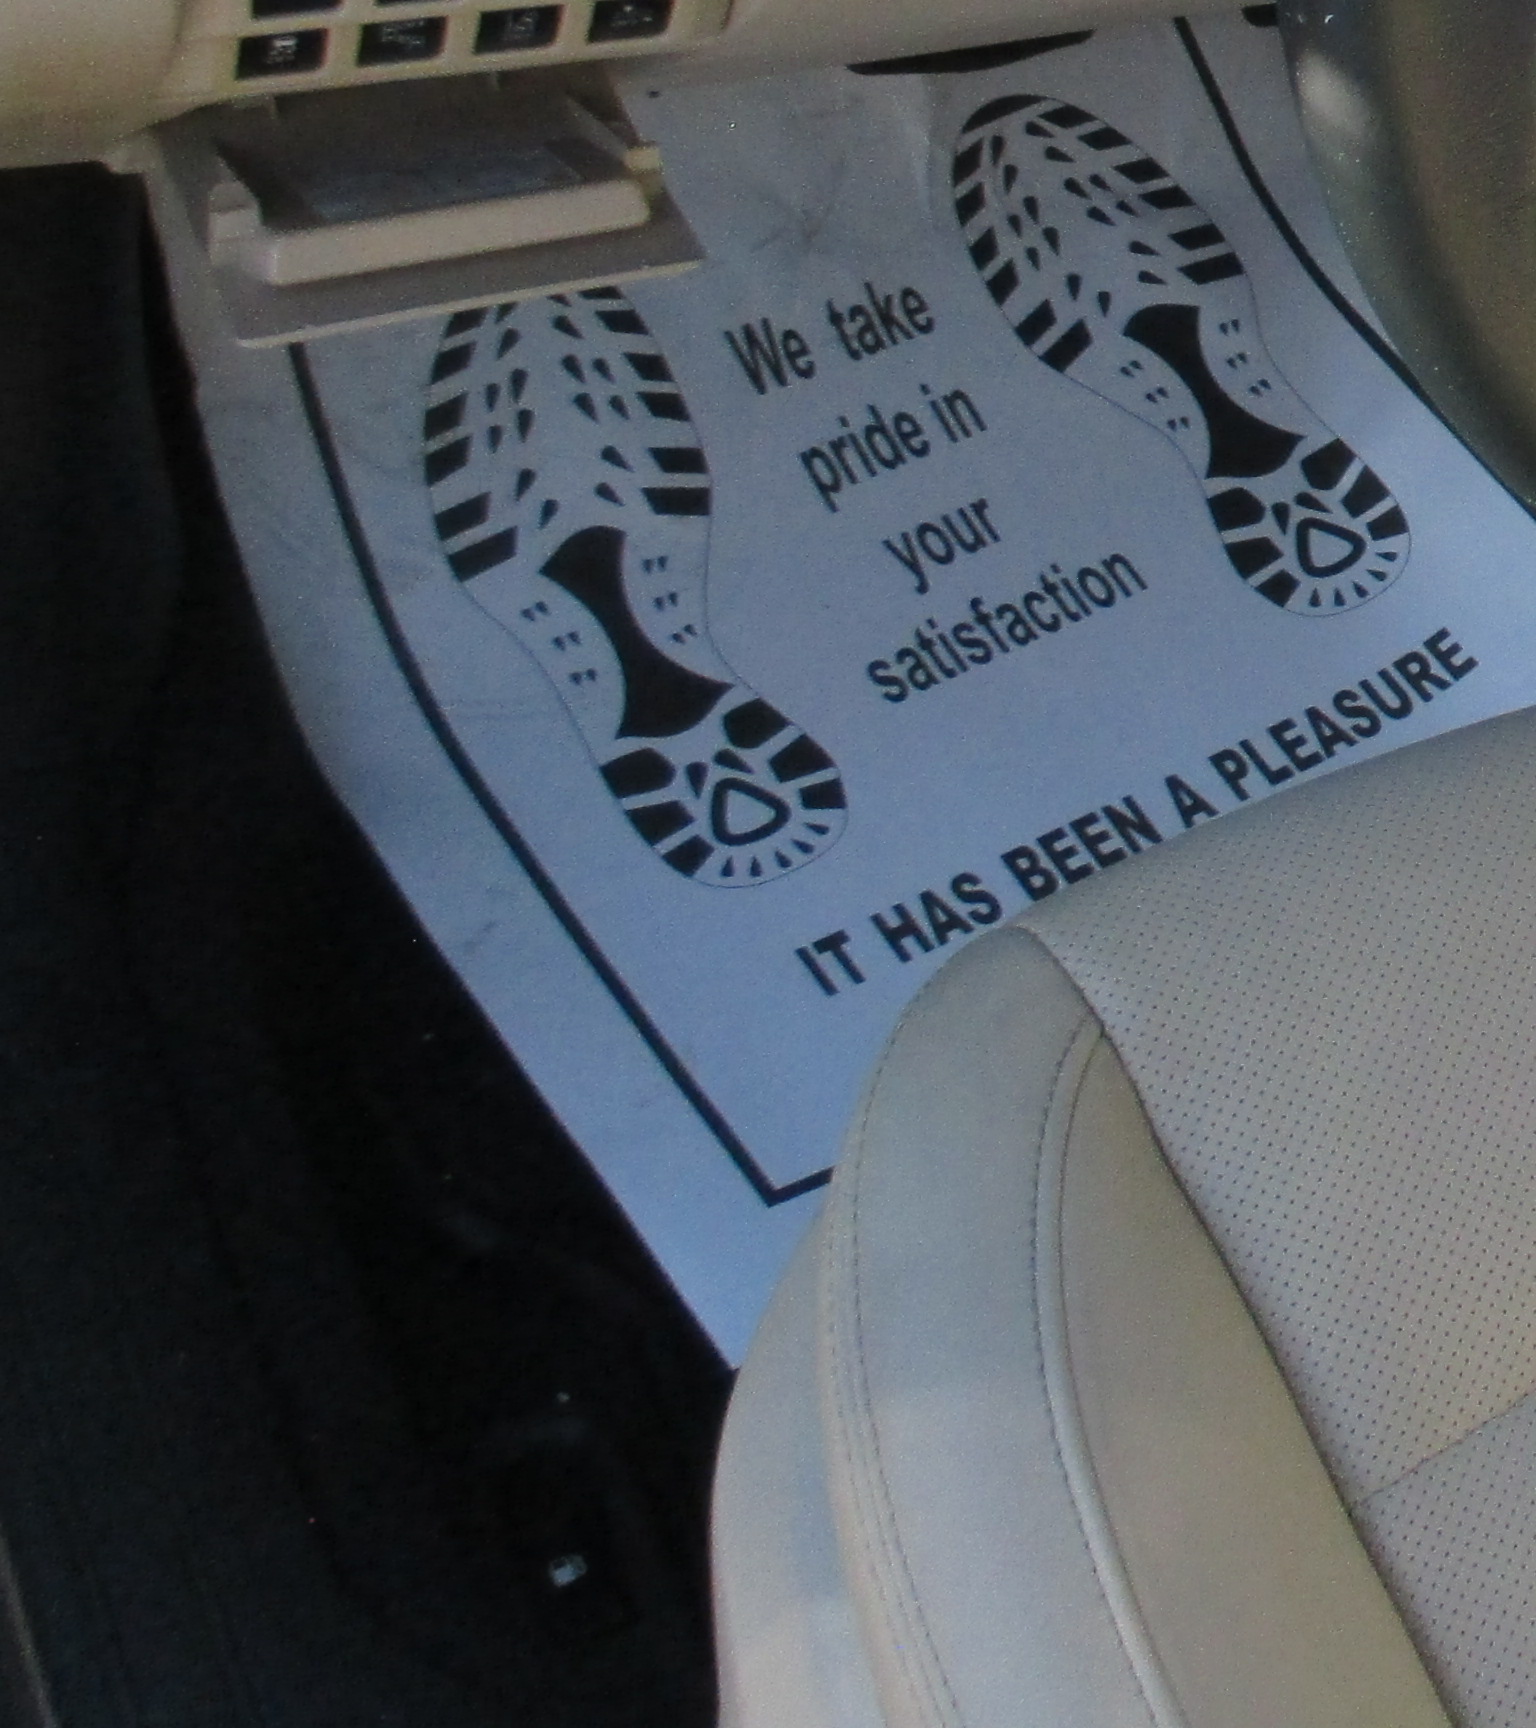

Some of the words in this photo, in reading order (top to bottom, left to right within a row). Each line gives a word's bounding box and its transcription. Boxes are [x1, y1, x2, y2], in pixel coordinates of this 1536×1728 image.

[725, 317, 817, 395] We
[827, 281, 935, 361] take
[800, 404, 931, 512] pride
[920, 383, 988, 443] in
[883, 497, 1001, 595] your
[867, 552, 1148, 703] satisfaction
[796, 929, 867, 997] IT
[871, 872, 1001, 962] HAS
[1001, 795, 1163, 901] BEEN
[1164, 773, 1218, 828] A
[1209, 626, 1479, 801] PLEASURE
